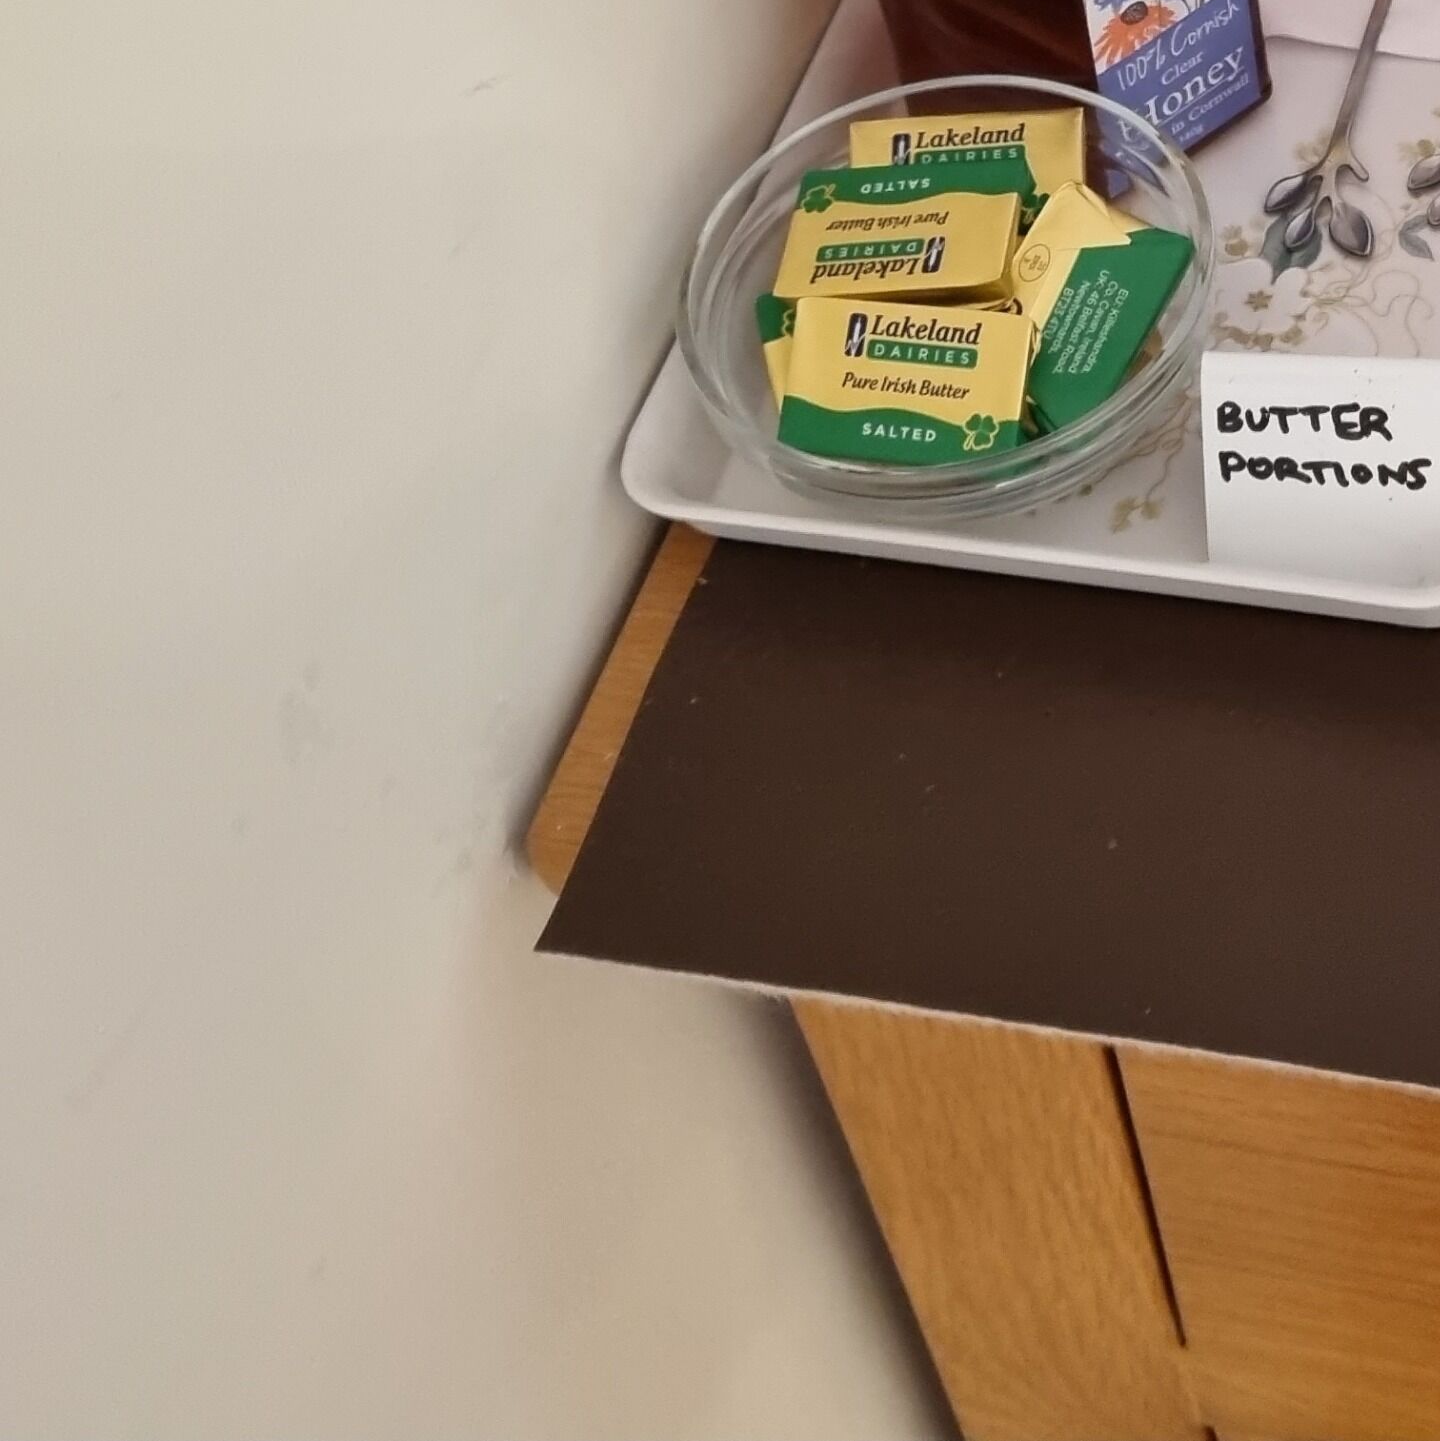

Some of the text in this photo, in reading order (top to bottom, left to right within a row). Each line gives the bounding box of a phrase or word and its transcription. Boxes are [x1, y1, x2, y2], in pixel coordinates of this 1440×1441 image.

[1116, 37, 1166, 92] 100%
[1161, 50, 1204, 86] Clear
[1188, 73, 1250, 122] Cornwall
[915, 123, 1026, 150] Lakeland
[921, 147, 1018, 164] DAIRIES
[860, 176, 930, 194] SALTED
[826, 210, 950, 232] Pure Irish Butter
[825, 242, 918, 259] DAIRIES
[810, 256, 918, 284] Lakeland
[1053, 286, 1074, 316] BT23
[1086, 289, 1100, 306] 46
[870, 314, 982, 345] Lakeland
[1068, 306, 1093, 343] Belfast
[874, 343, 971, 364] DAIRIES
[842, 372, 970, 399] Pure Irish Butter
[862, 422, 937, 443] SALTED
[1217, 400, 1393, 442] BUTTER
[1218, 450, 1432, 491] PORTIONS
